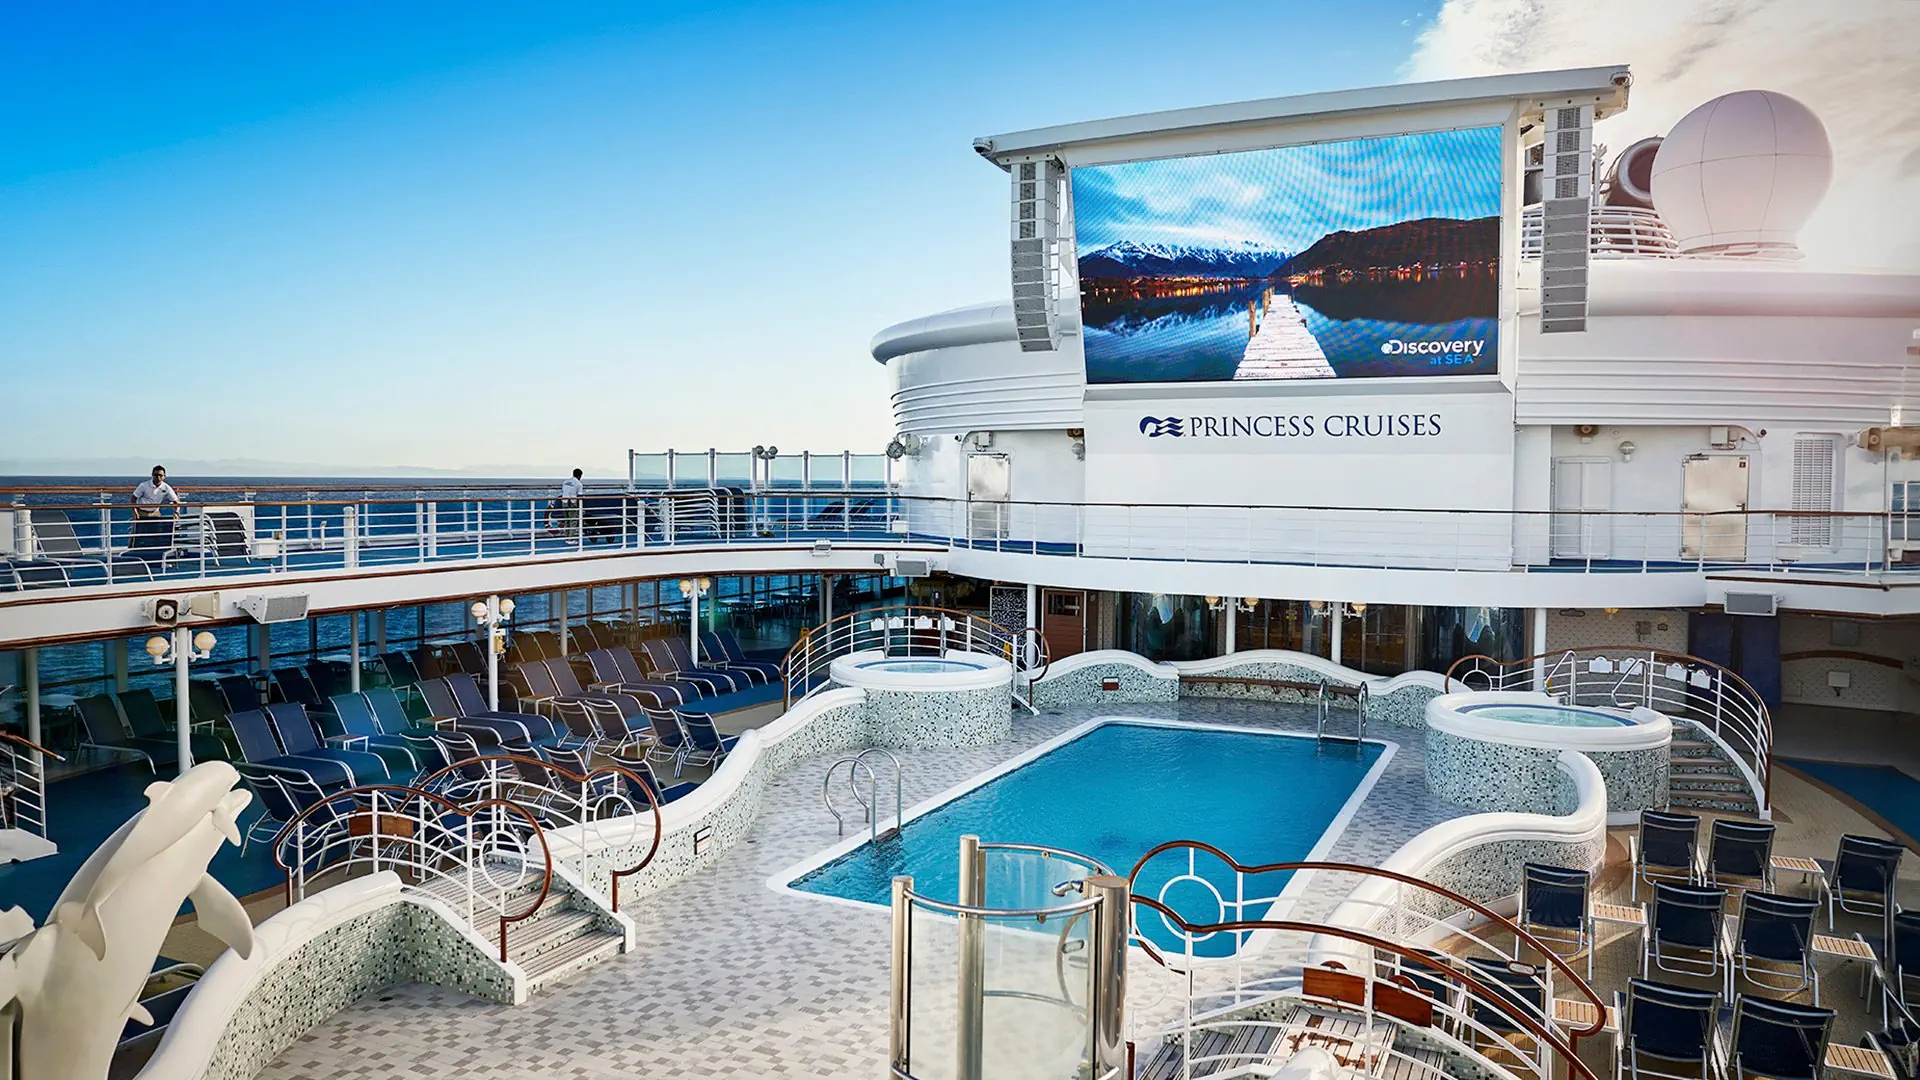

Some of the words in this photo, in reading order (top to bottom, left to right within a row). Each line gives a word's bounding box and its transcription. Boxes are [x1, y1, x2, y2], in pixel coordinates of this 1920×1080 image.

[1388, 339, 1485, 357] Discovery
[1430, 357, 1442, 365] at
[1445, 354, 1474, 365] SEA
[1190, 415, 1315, 437] PRINCESS
[1324, 414, 1441, 437] CRUISES
